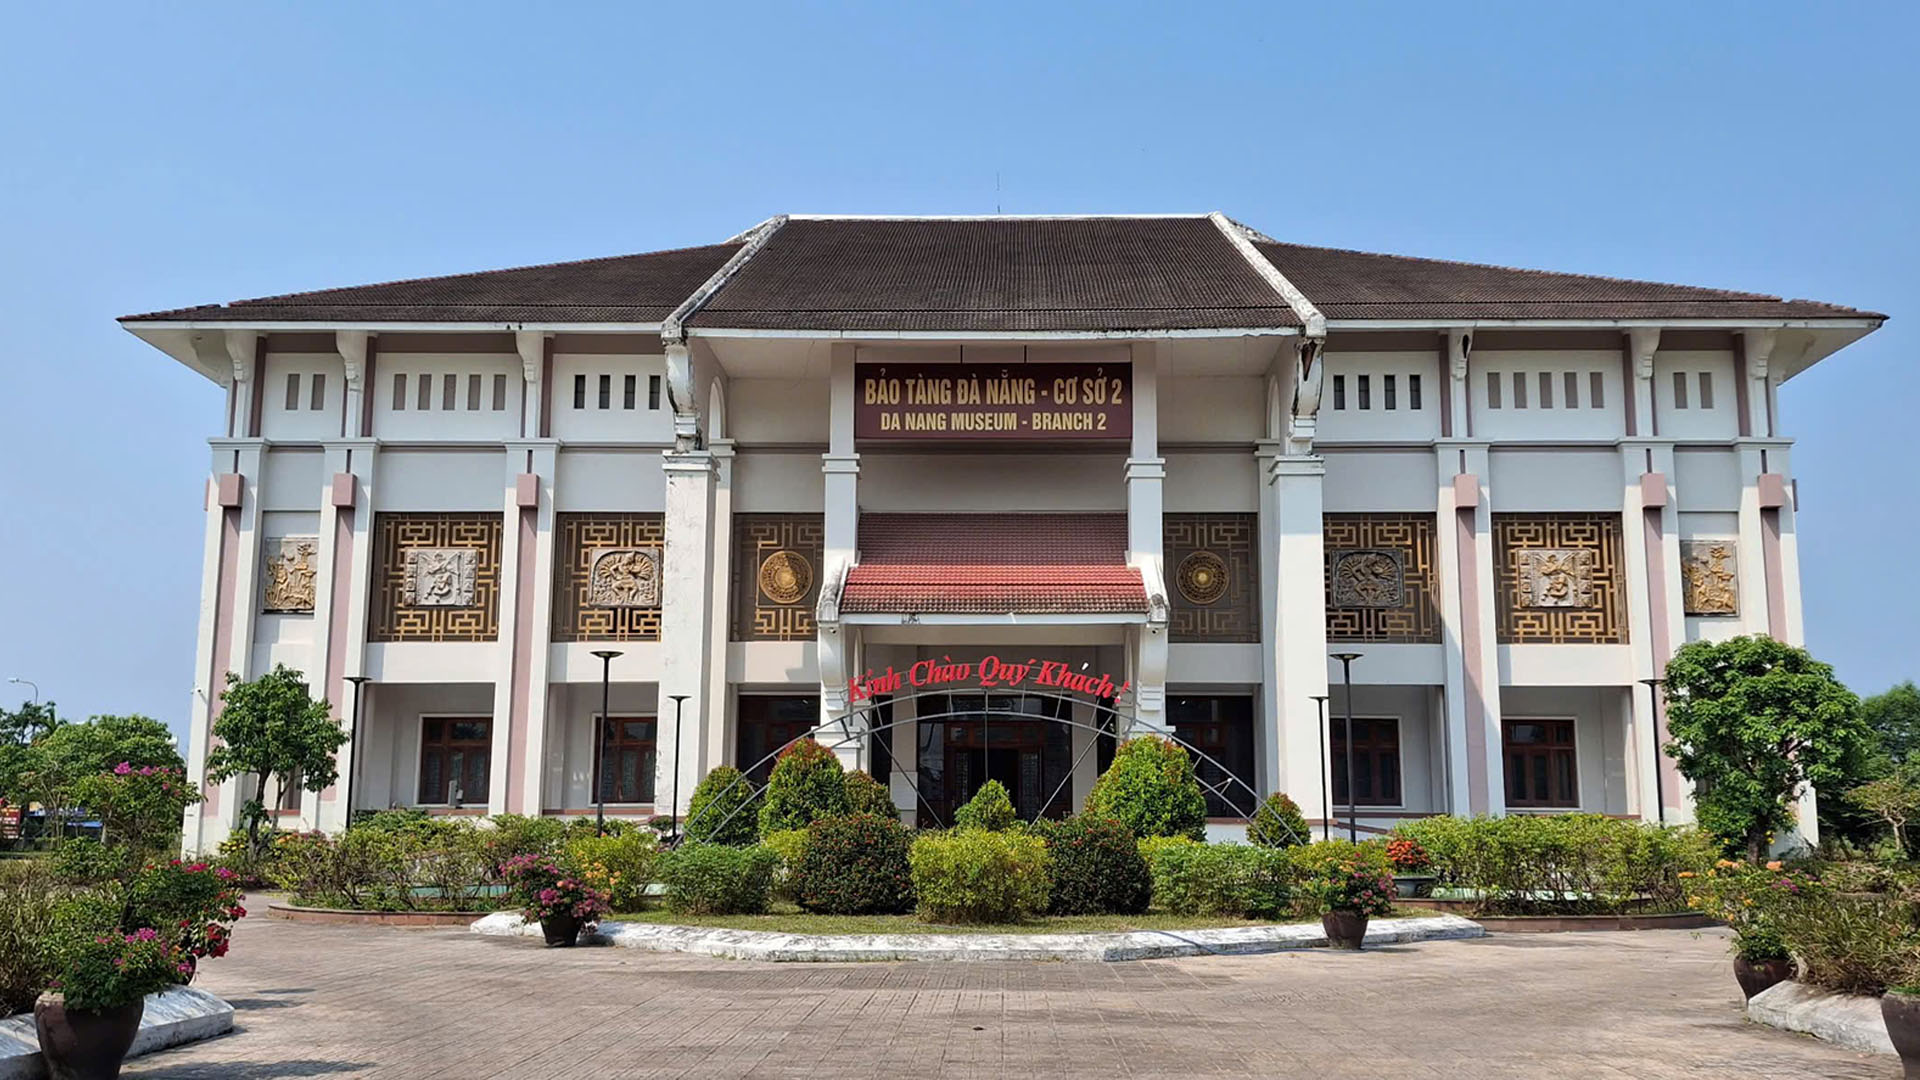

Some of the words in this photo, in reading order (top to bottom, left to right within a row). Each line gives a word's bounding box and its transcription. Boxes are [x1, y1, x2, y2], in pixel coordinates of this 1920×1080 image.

[865, 368, 900, 405] BẢO
[906, 373, 952, 405] TÀNG
[957, 373, 981, 405] ĐÀ
[986, 369, 1036, 405] NẴNG
[1053, 376, 1078, 405] CƠ
[1082, 368, 1108, 405] SỞ
[1112, 379, 1123, 405] 2
[881, 413, 900, 431] DA
[905, 413, 947, 431] NANG
[951, 413, 1017, 431] MUSEUM
[1032, 413, 1093, 431] BRANCH
[1097, 413, 1107, 431] 2
[909, 655, 970, 687] Chào
[978, 655, 1037, 686] Quý
[1037, 660, 1113, 698] Khách
